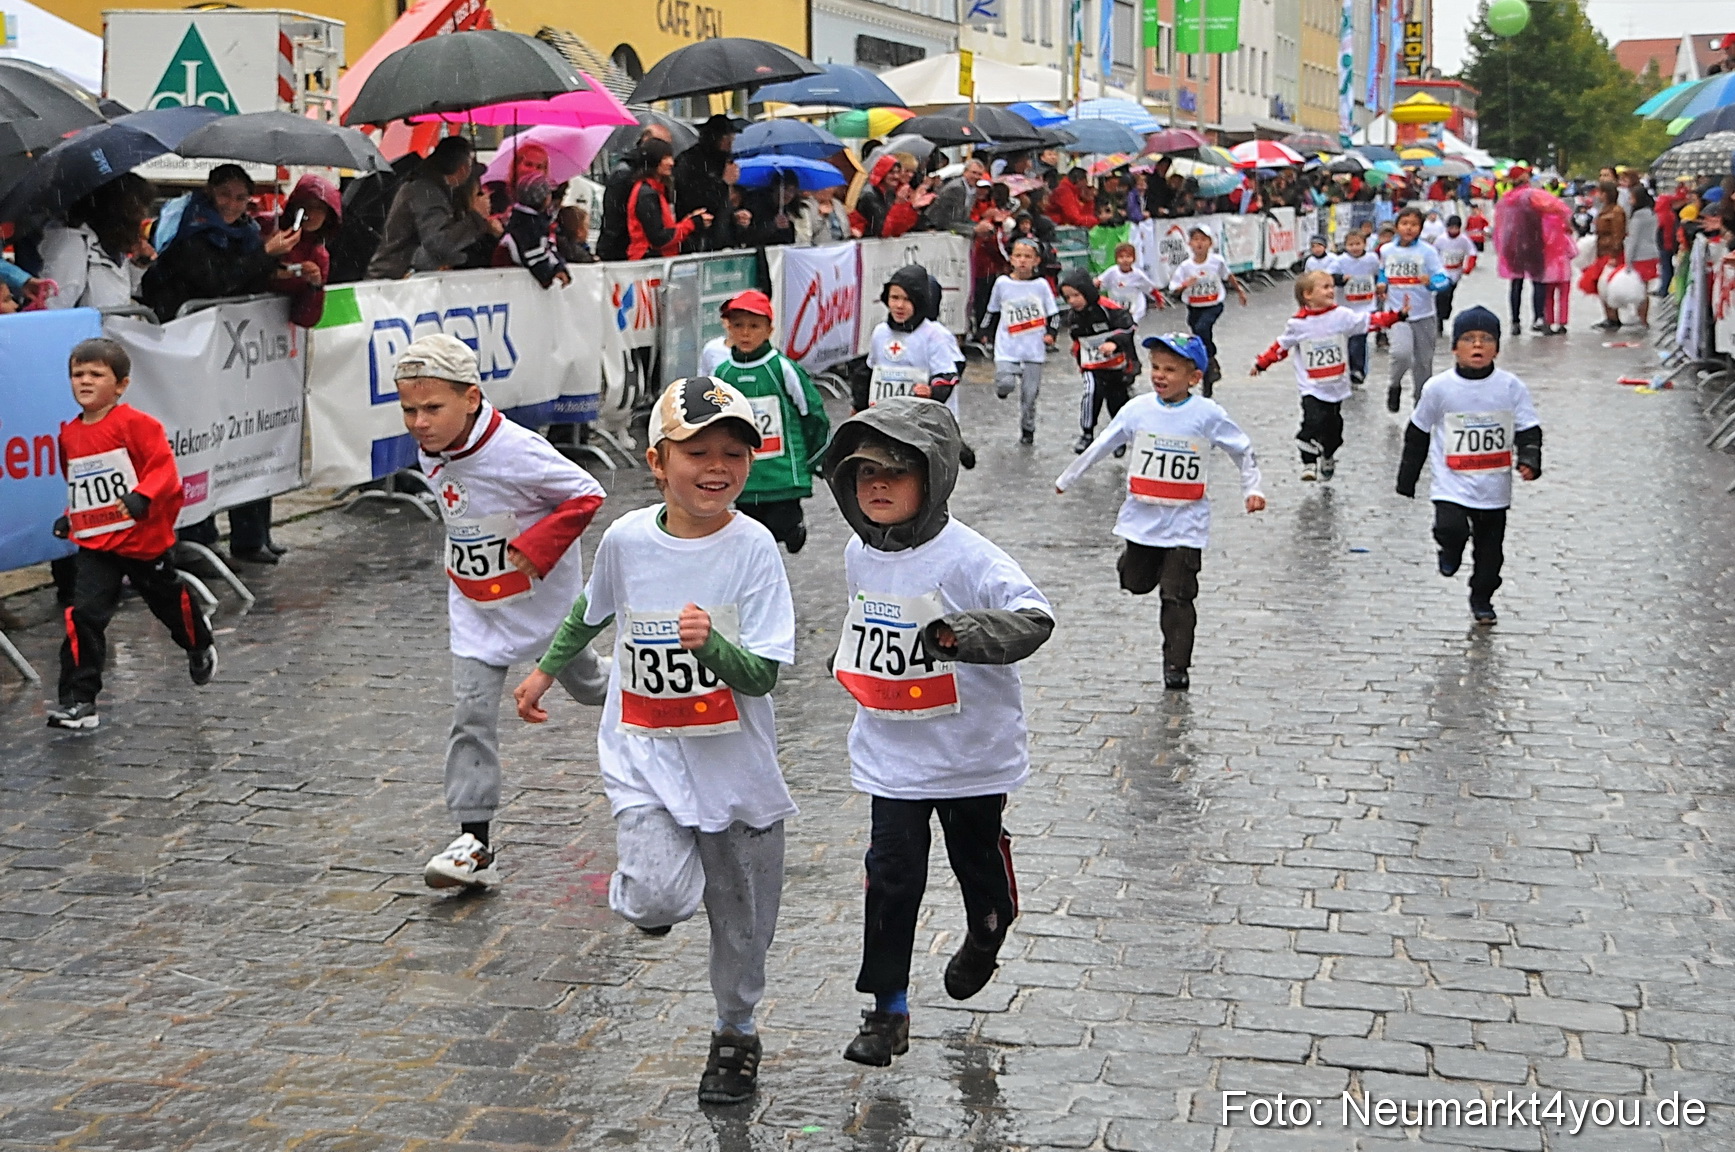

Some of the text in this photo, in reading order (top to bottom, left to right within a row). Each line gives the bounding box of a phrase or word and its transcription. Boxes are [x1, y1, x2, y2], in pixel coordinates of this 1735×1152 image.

[1007, 303, 1041, 323] 7035
[222, 318, 298, 380] Xplus!
[370, 303, 519, 406] BK
[1306, 346, 1343, 368] 7233
[1453, 427, 1505, 452] 7063
[1141, 450, 1201, 480] 7165
[68, 471, 129, 509] 7108
[864, 601, 901, 618] BOCK
[851, 624, 937, 677] 7254
